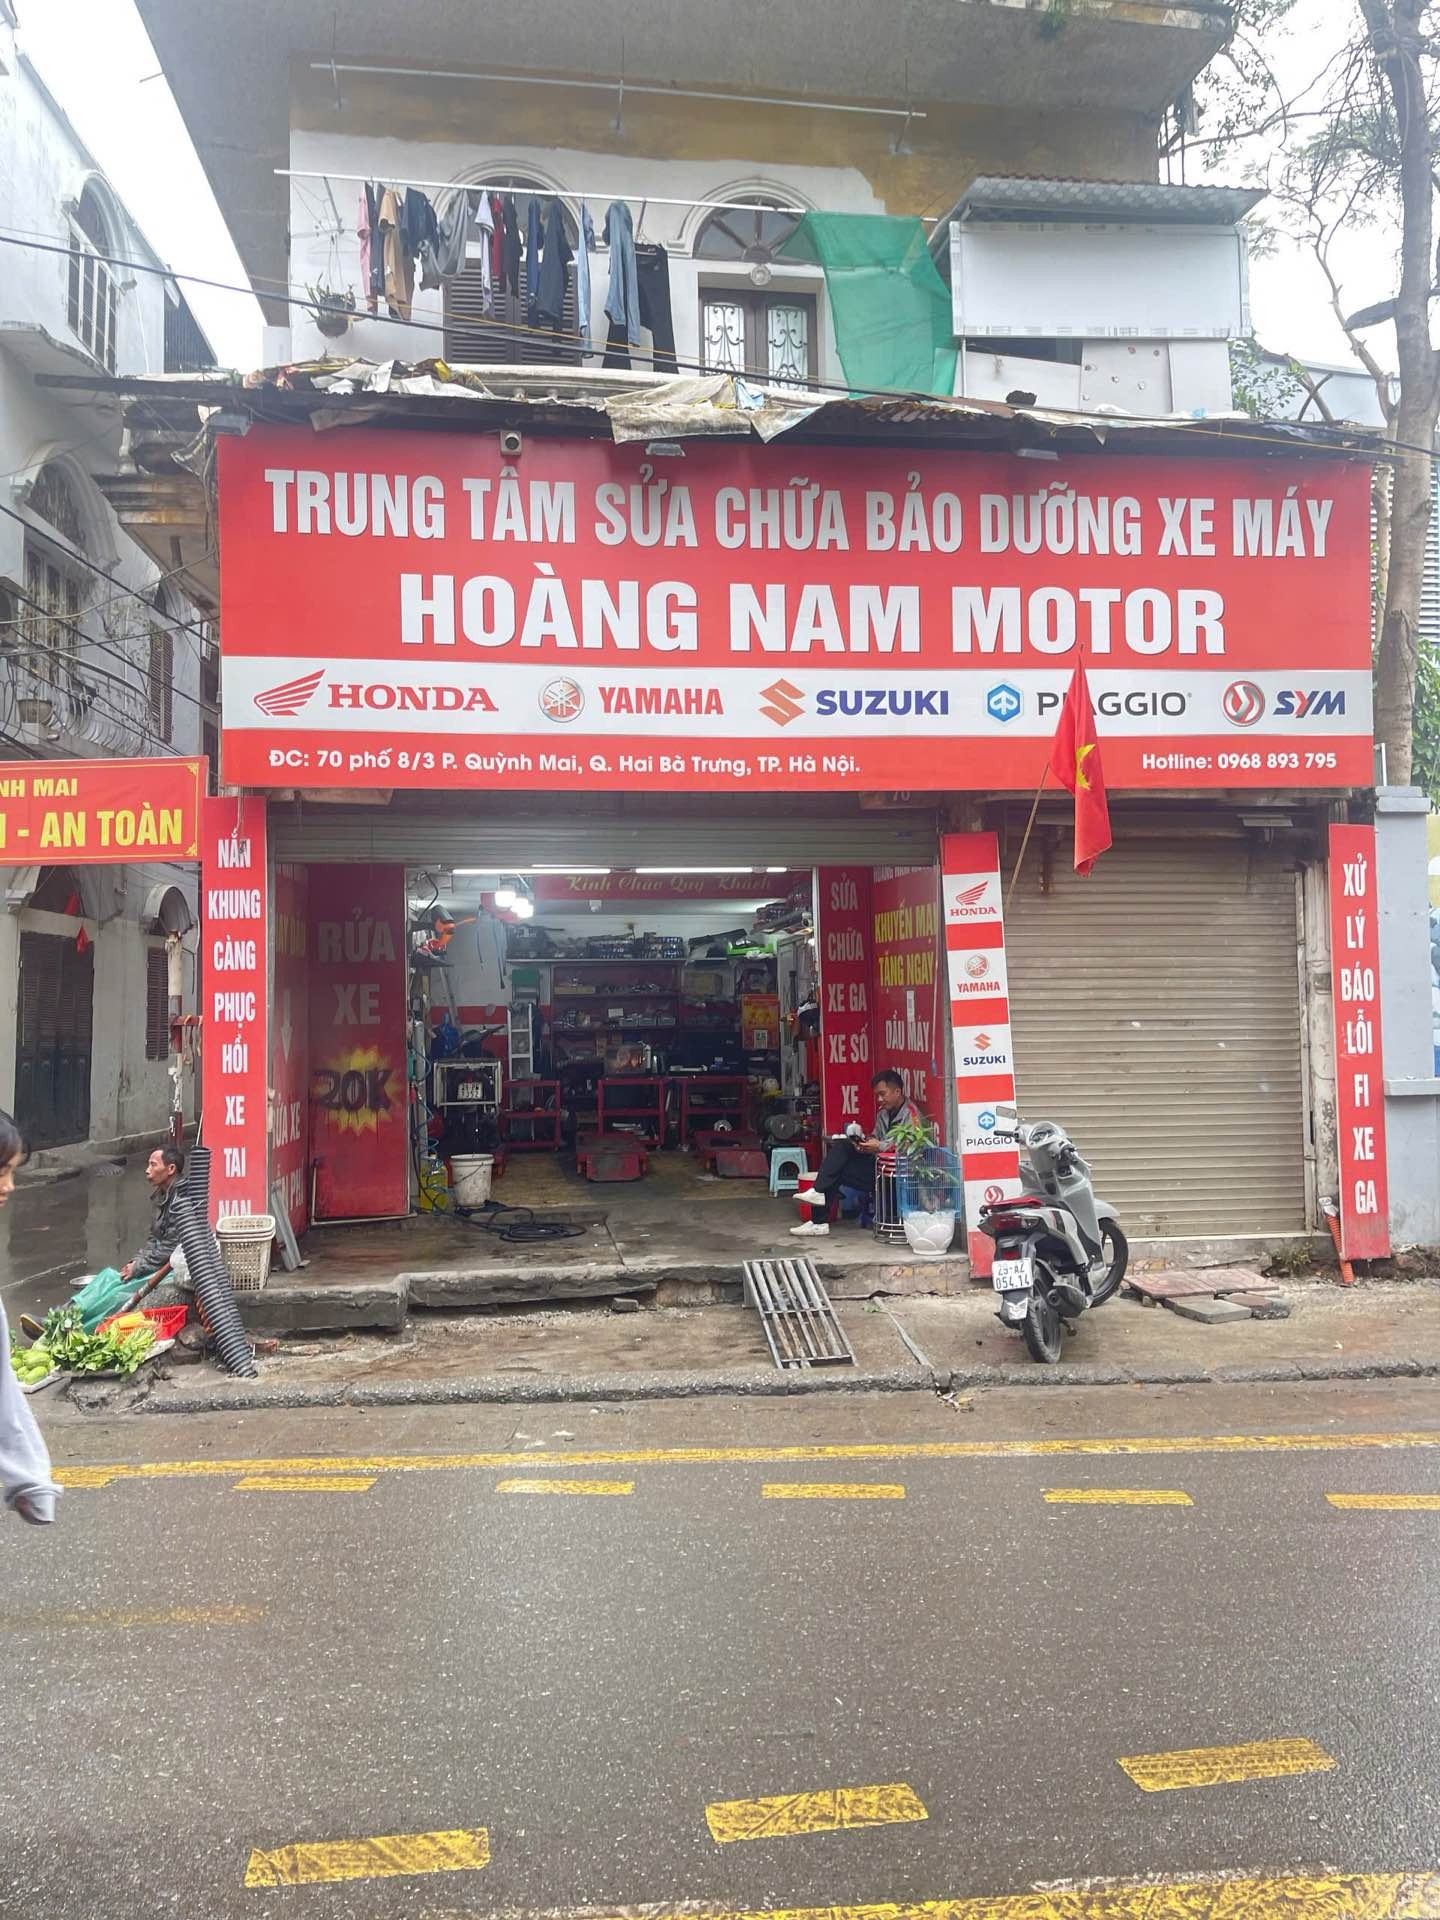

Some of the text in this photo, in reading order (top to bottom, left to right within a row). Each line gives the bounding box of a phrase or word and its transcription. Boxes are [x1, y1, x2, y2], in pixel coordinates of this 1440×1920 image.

[264, 464, 1333, 558] TRUNG TÂM SỬA CHỮA BẢO DƯỠNG XE MÁY
[400, 562, 1226, 655] HOÀNG NAM MOTOR
[327, 683, 499, 713] HONDA
[598, 686, 725, 715] YAMAHA
[816, 689, 949, 717] SUZUKI
[1036, 691, 1186, 717] PGGIO
[1272, 690, 1345, 718] SYM
[268, 747, 860, 777] ĐC: 70 phố 8/3 P. Quỳnh Mai, Q. Hai Bà Trưng, TP. Hà Nội.
[1142, 753, 1337, 769] Hotline: 0968 893 795
[33, 778, 78, 797] MAI
[40, 812, 86, 848] AN
[97, 802, 183, 847] TOÀN
[831, 872, 858, 911] SỬA
[1343, 853, 1367, 896] XỬ
[208, 889, 261, 920] KHUNG
[875, 897, 913, 944] KHUYẾN
[950, 906, 997, 917] HONDA
[319, 907, 396, 962] RỬA
[828, 926, 864, 961] CHỮA
[1345, 909, 1366, 949] LÝ
[213, 935, 256, 971] CÀNG
[907, 952, 934, 985] NGAY
[828, 983, 867, 1012] XE GA
[957, 981, 1000, 993] YAMAHA
[1340, 961, 1375, 1001] BÁO
[214, 992, 256, 1028] PHỤC
[333, 983, 381, 1024] XE
[829, 1023, 869, 1063] XE SỐ
[1346, 1009, 1373, 1055] LỖI
[963, 1055, 1006, 1066] SUZUKI
[312, 1069, 392, 1113] 20K
[841, 1085, 859, 1115] XE
[913, 1070, 927, 1102] XE
[1354, 1073, 1370, 1107] FI
[225, 1096, 245, 1125] XE
[290, 1101, 301, 1142] XE
[966, 1136, 1013, 1146] PIAGGIO
[1353, 1126, 1375, 1161] XE
[224, 1147, 246, 1177] TAI
[1355, 1179, 1378, 1214] GA
